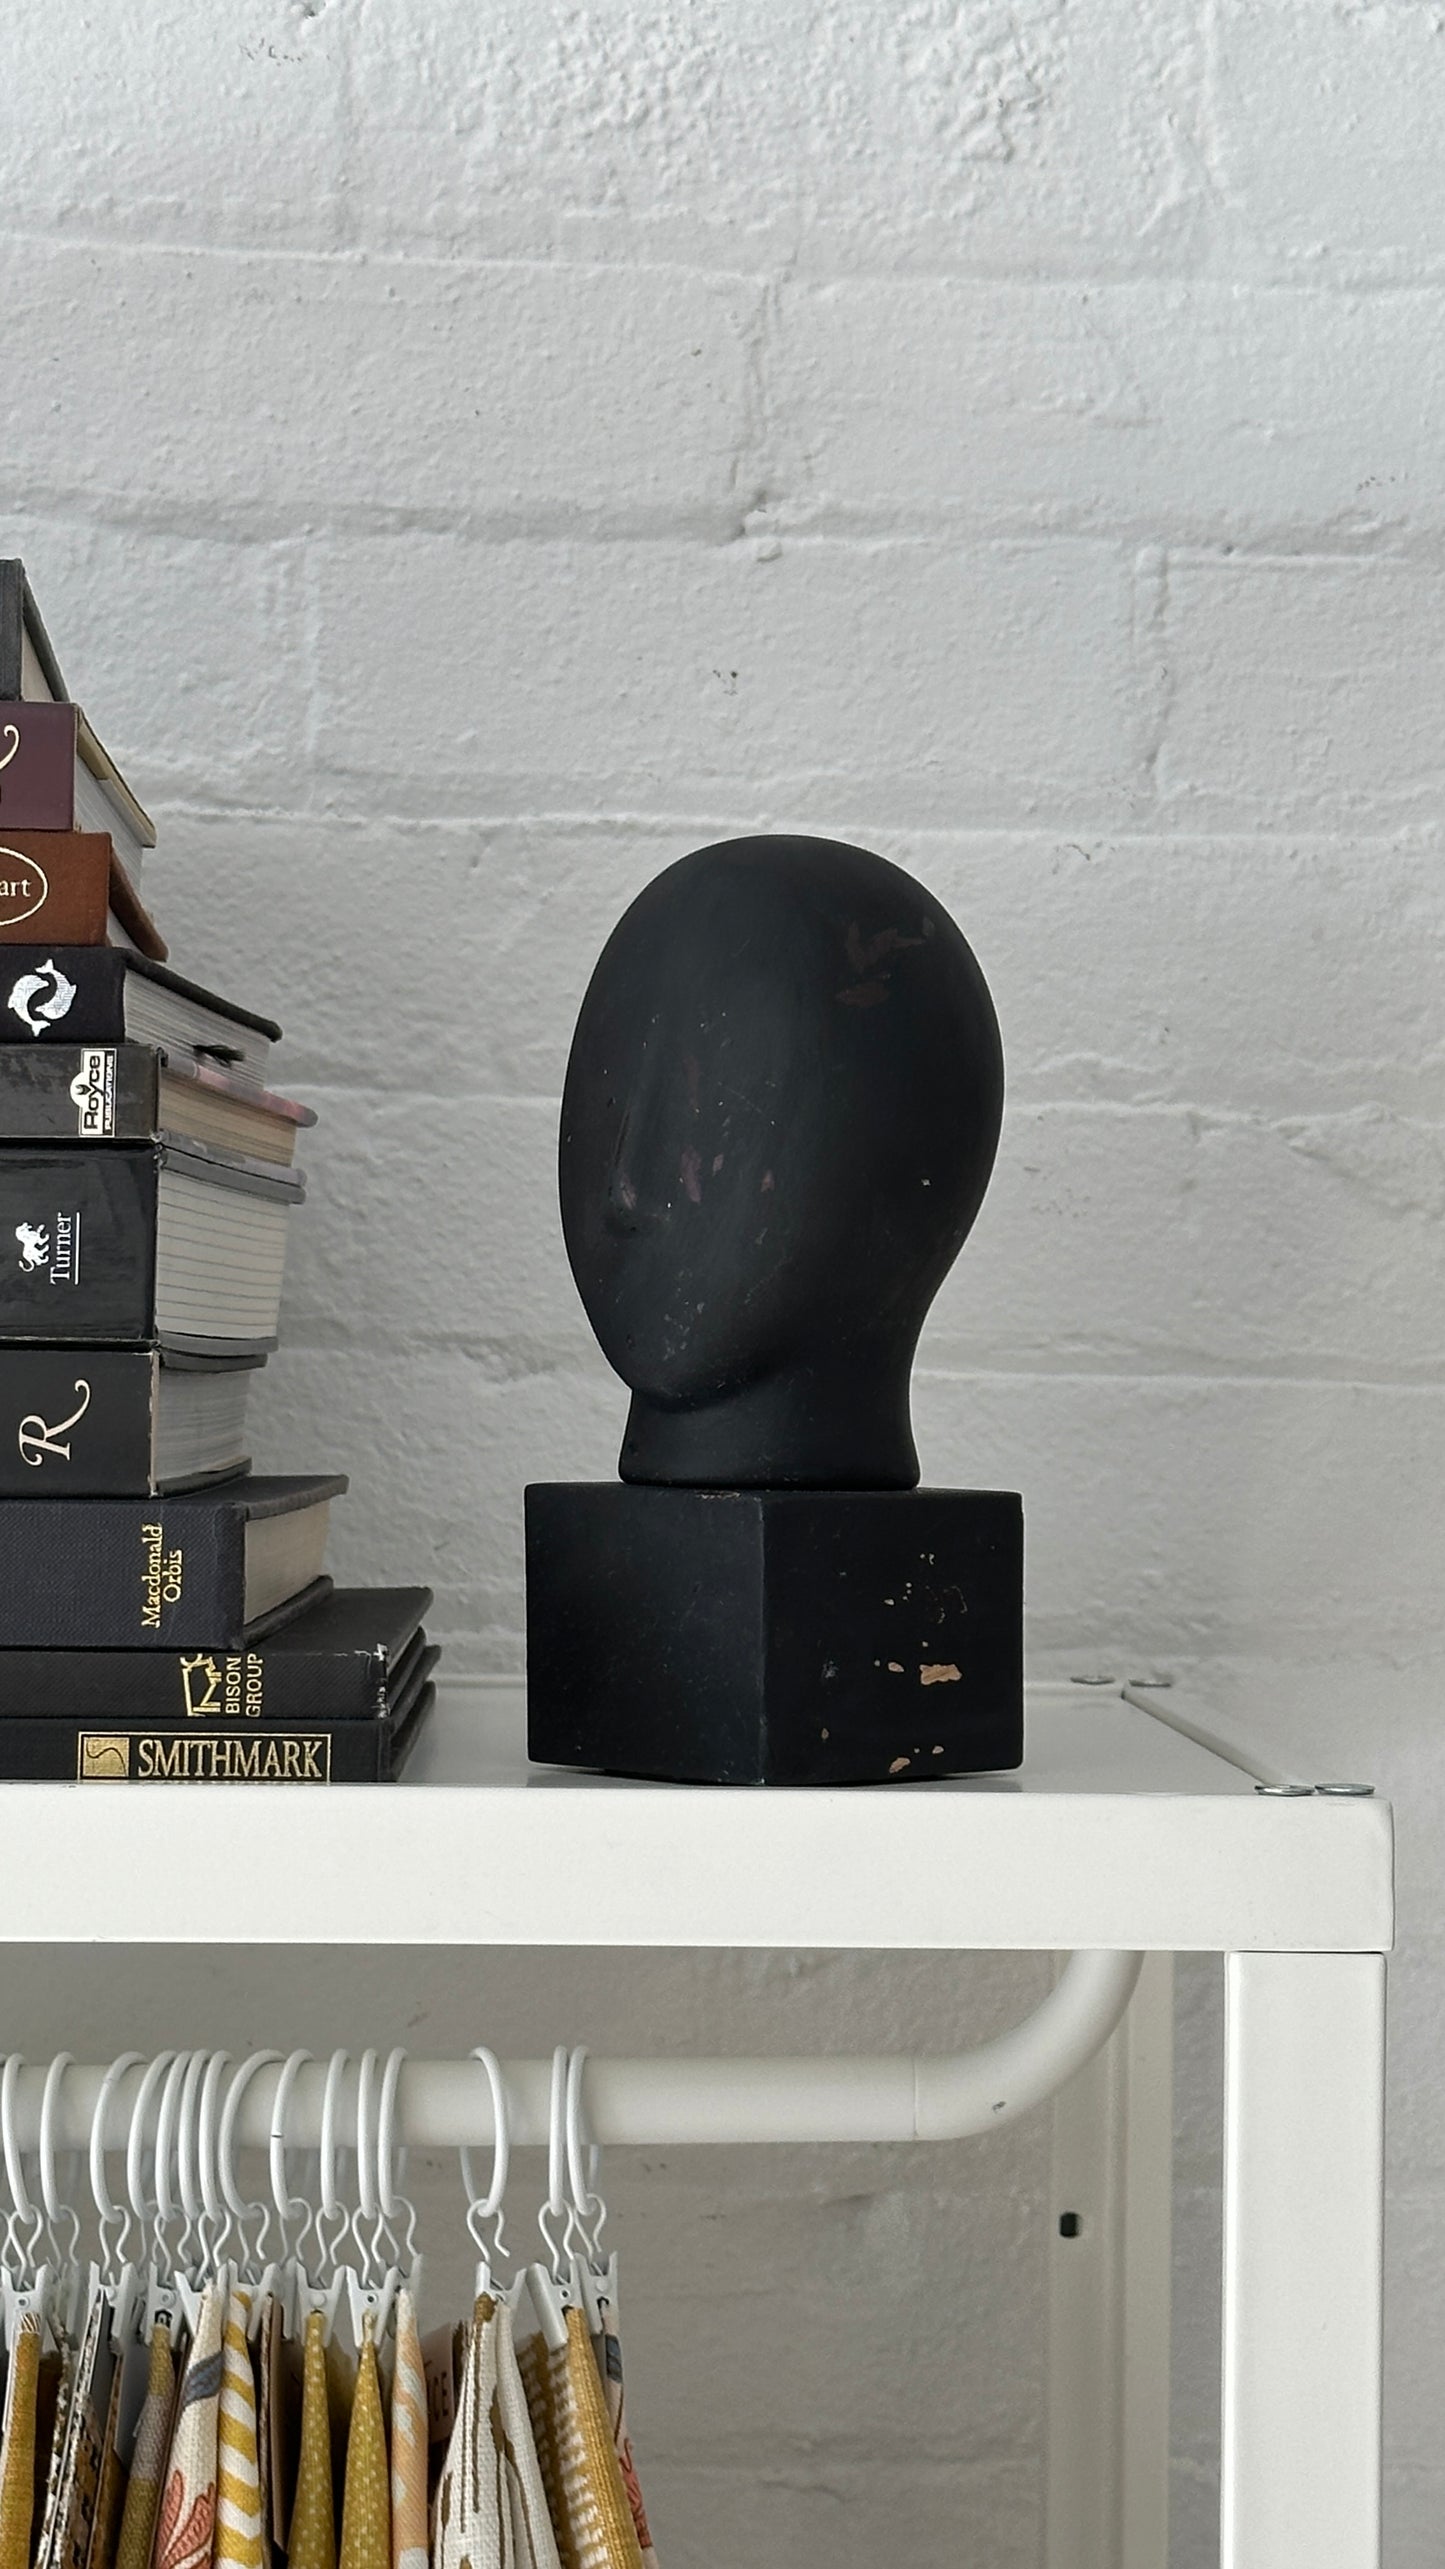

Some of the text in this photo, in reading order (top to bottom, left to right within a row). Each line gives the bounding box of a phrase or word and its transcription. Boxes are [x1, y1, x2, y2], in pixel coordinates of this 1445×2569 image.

[0, 879, 32, 897] art
[83, 1055, 105, 1130] Royce
[50, 1212, 72, 1285] Turner
[18, 1379, 91, 1468] R
[141, 1522, 163, 1629] Macdonald
[162, 1549, 182, 1602] Orbis
[225, 1656, 242, 1714] BISON
[245, 1653, 264, 1718] GROUP
[138, 1739, 324, 1778] SMITHMARK
